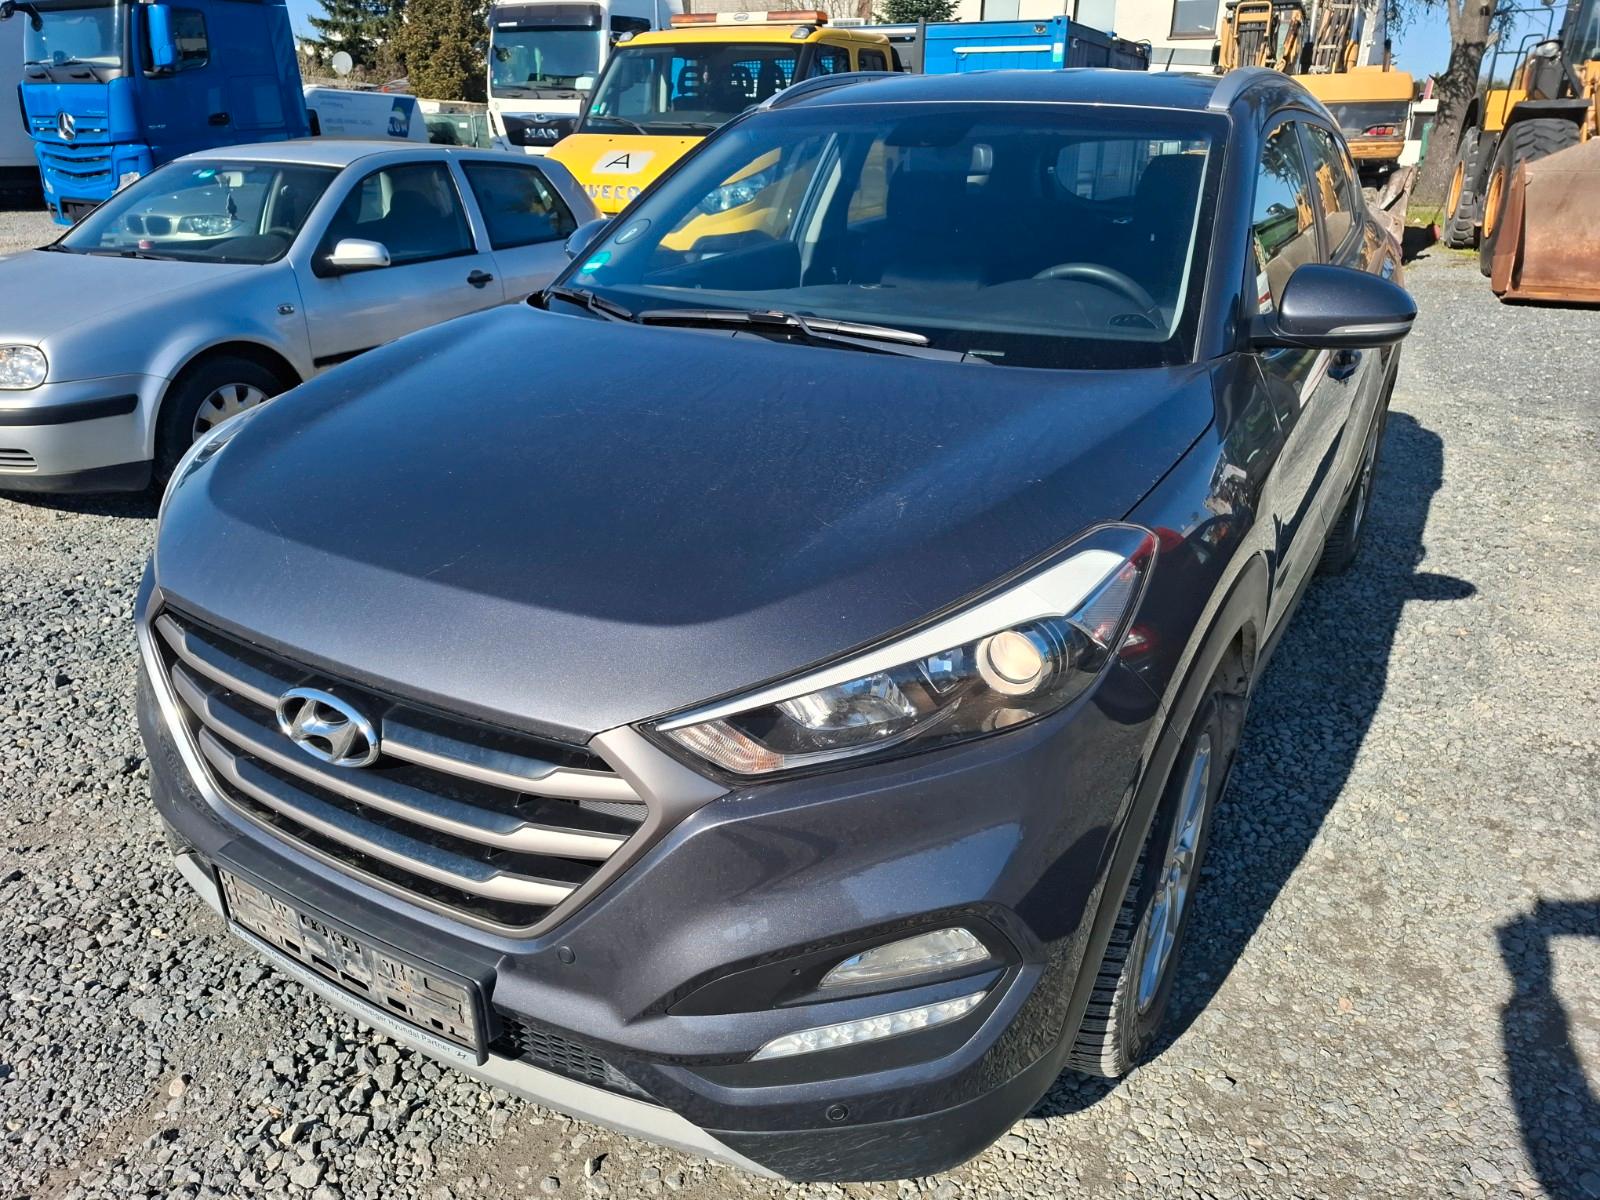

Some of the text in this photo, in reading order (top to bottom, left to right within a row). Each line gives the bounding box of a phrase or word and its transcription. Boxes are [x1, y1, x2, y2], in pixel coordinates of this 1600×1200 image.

[524, 127, 559, 139] MAN
[605, 153, 630, 169] A
[388, 1020, 420, 1040] Hyundai
[421, 1034, 451, 1052] Partner
